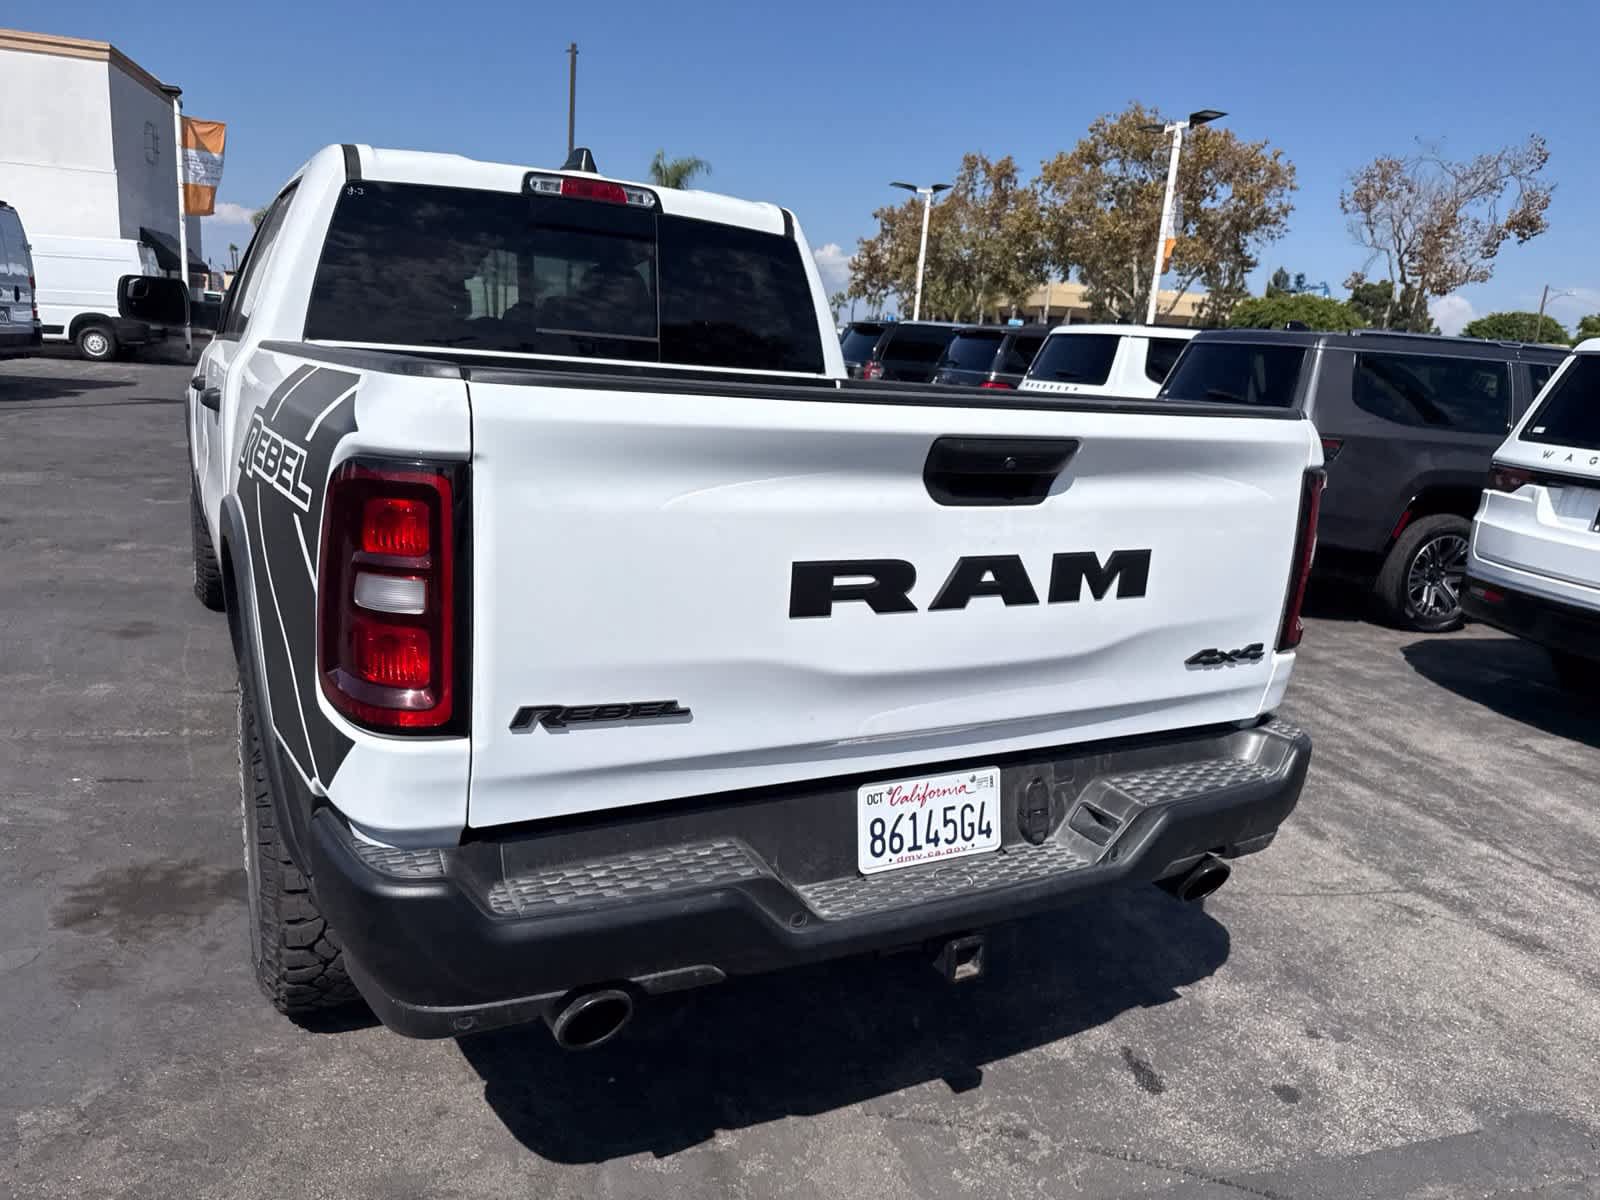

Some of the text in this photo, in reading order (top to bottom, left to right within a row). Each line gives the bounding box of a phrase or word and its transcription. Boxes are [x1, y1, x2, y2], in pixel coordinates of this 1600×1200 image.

[240, 412, 313, 513] REBEL
[789, 548, 1152, 619] RAM
[508, 699, 692, 731] REBEL
[866, 792, 883, 806] OCT
[889, 781, 977, 809] California
[869, 801, 993, 859] 86145G4
[896, 844, 969, 864] dmv.ca.gov
